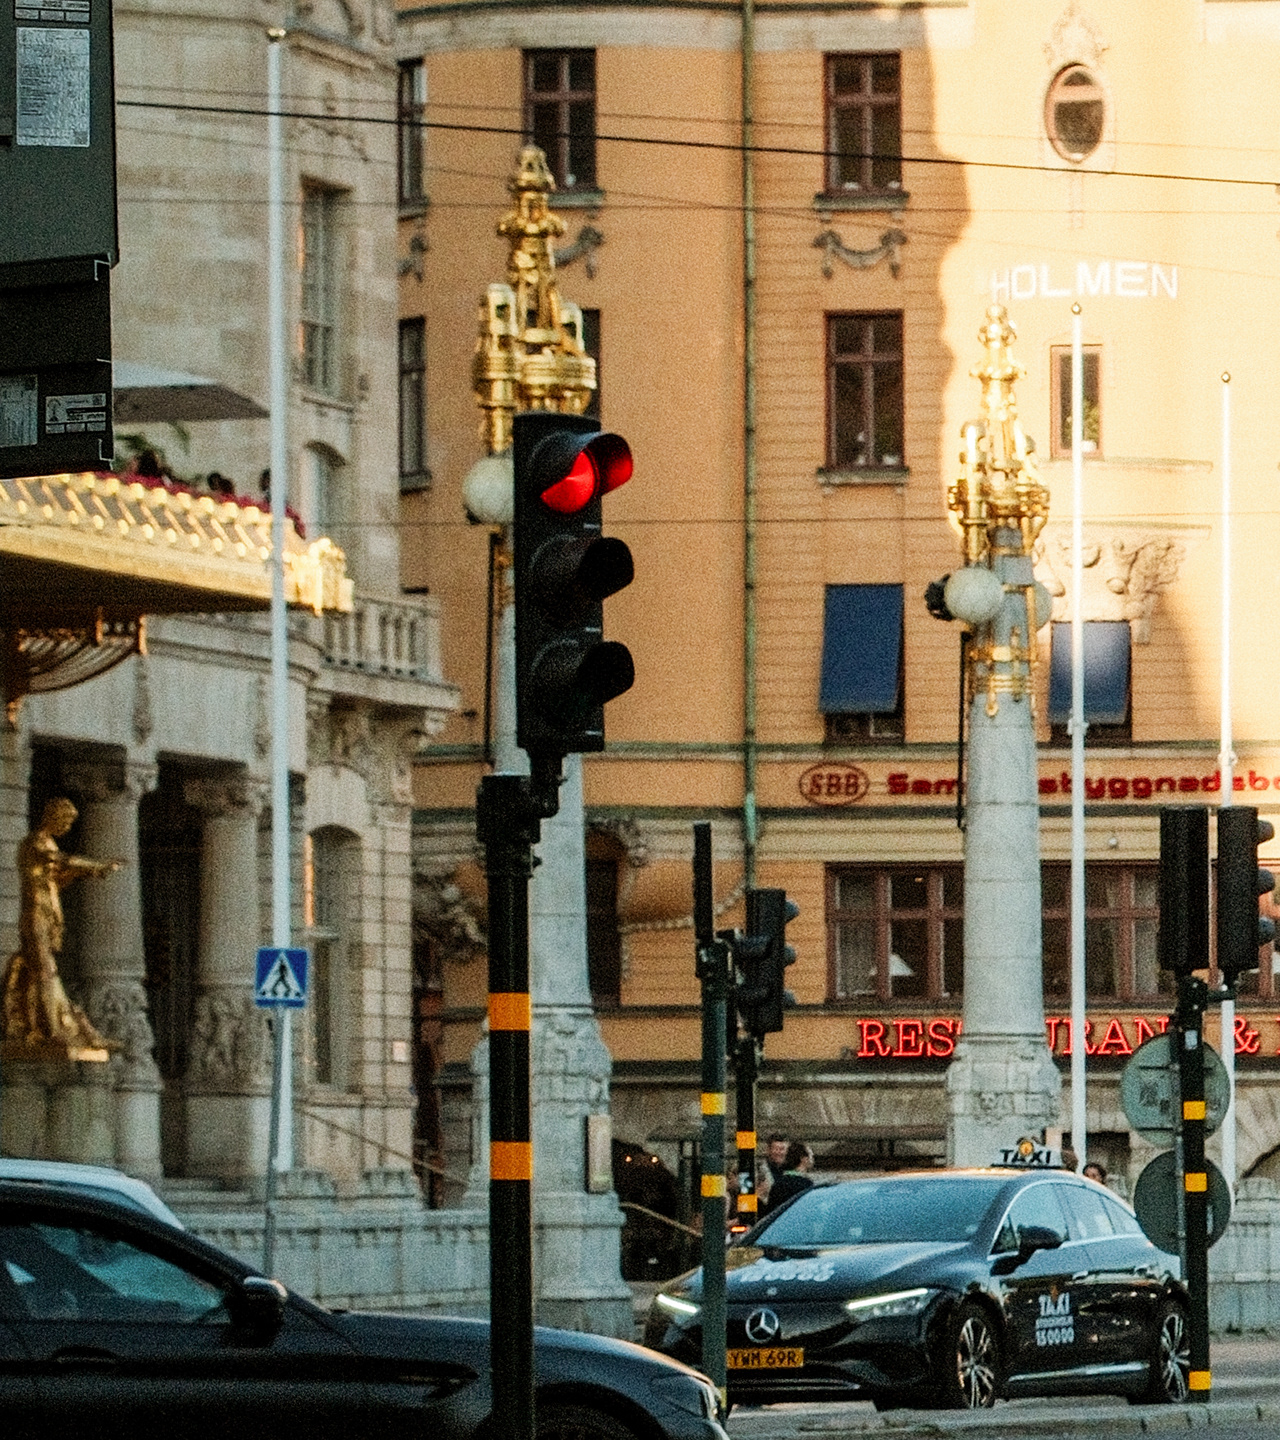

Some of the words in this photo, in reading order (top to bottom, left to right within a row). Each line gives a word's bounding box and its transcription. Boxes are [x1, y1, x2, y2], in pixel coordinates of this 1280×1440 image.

[991, 260, 1178, 304] HOLMEN
[808, 773, 860, 798] SBB
[1000, 1148, 1052, 1164] TAXI
[1038, 1292, 1071, 1316] TAXI
[730, 1351, 761, 1367] YWM
[765, 1349, 797, 1367] 69R
